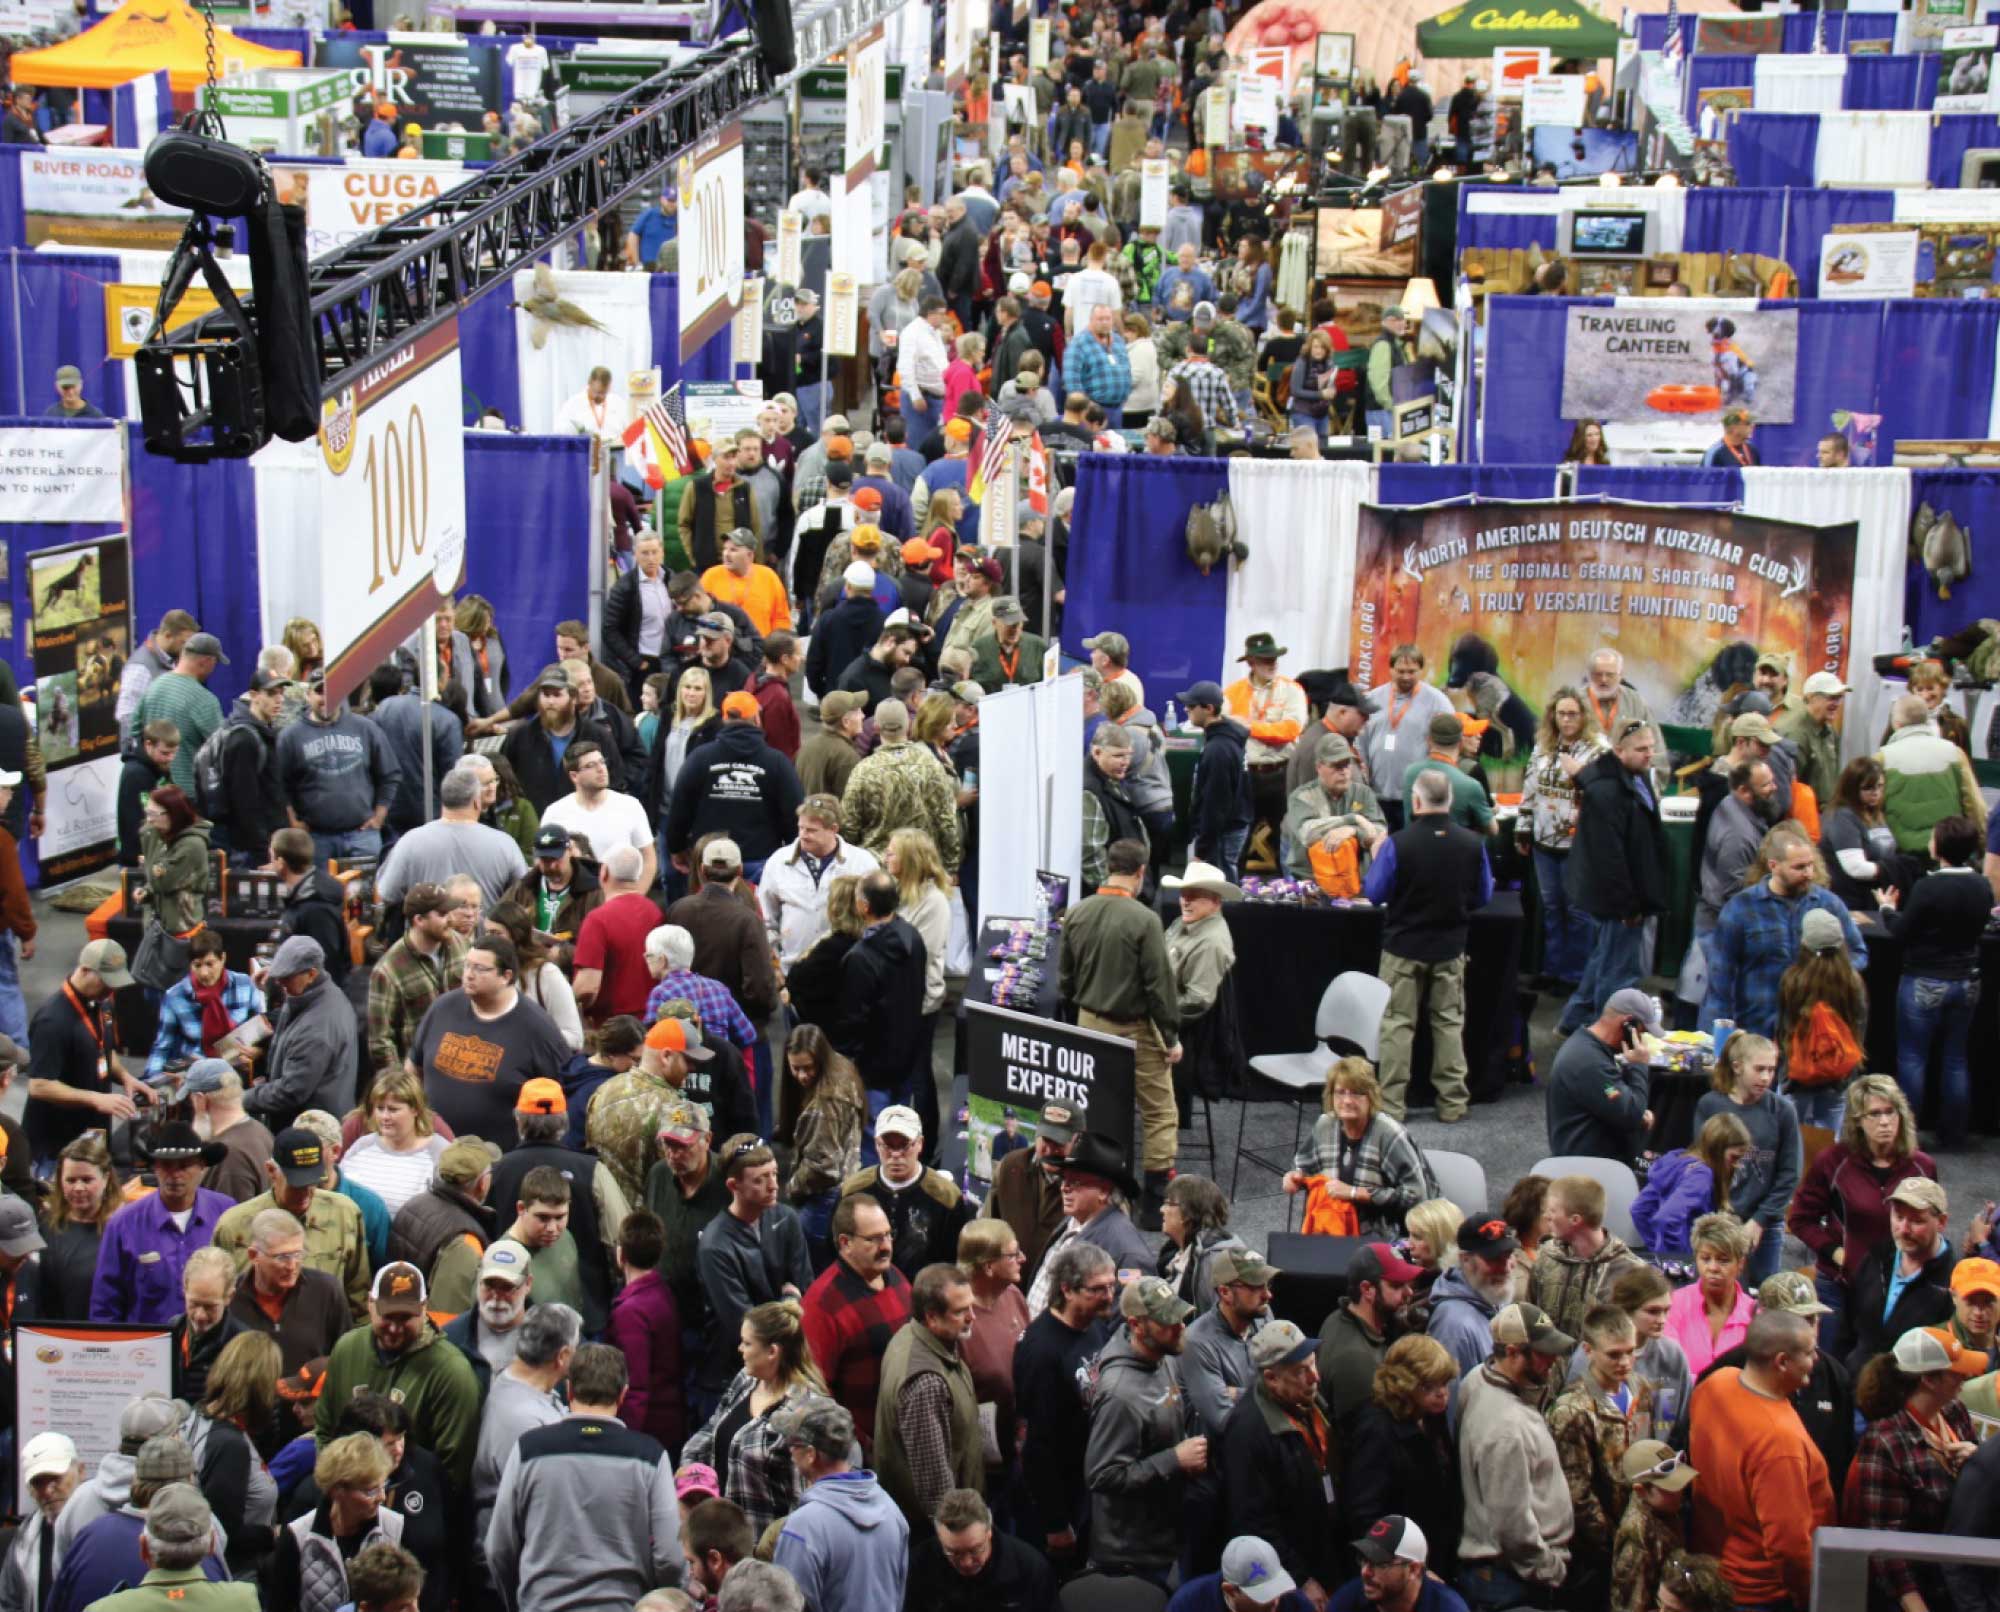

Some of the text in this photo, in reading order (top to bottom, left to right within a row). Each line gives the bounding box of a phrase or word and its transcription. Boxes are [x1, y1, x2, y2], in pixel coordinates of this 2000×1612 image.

[1471, 9, 1580, 30] Cabela's
[33, 159, 82, 177] RIVER
[86, 162, 136, 179] ROAD
[344, 172, 441, 198] CUGA
[1579, 315, 1676, 333] TRAVELING
[1606, 337, 1691, 354] CANTEEN
[9, 449, 65, 459] FOR THE
[14, 484, 29, 493] TO
[363, 403, 428, 595] 100
[1418, 520, 1789, 583] NORTH AMERICAN DEUTSCH KURZHAAR CLUB
[1468, 563, 1736, 592] THE ORIGINAL GERMAN SHORTHAIR
[1479, 592, 1526, 612] TRULY
[1534, 592, 1620, 614] VERSATILE
[1628, 596, 1700, 620] HUNTING
[1825, 622, 1841, 673] C.ORG
[303, 734, 364, 759] MENARDS
[1001, 1031, 1096, 1080] MEET OUR
[1006, 1065, 1089, 1110] EXPERTS
